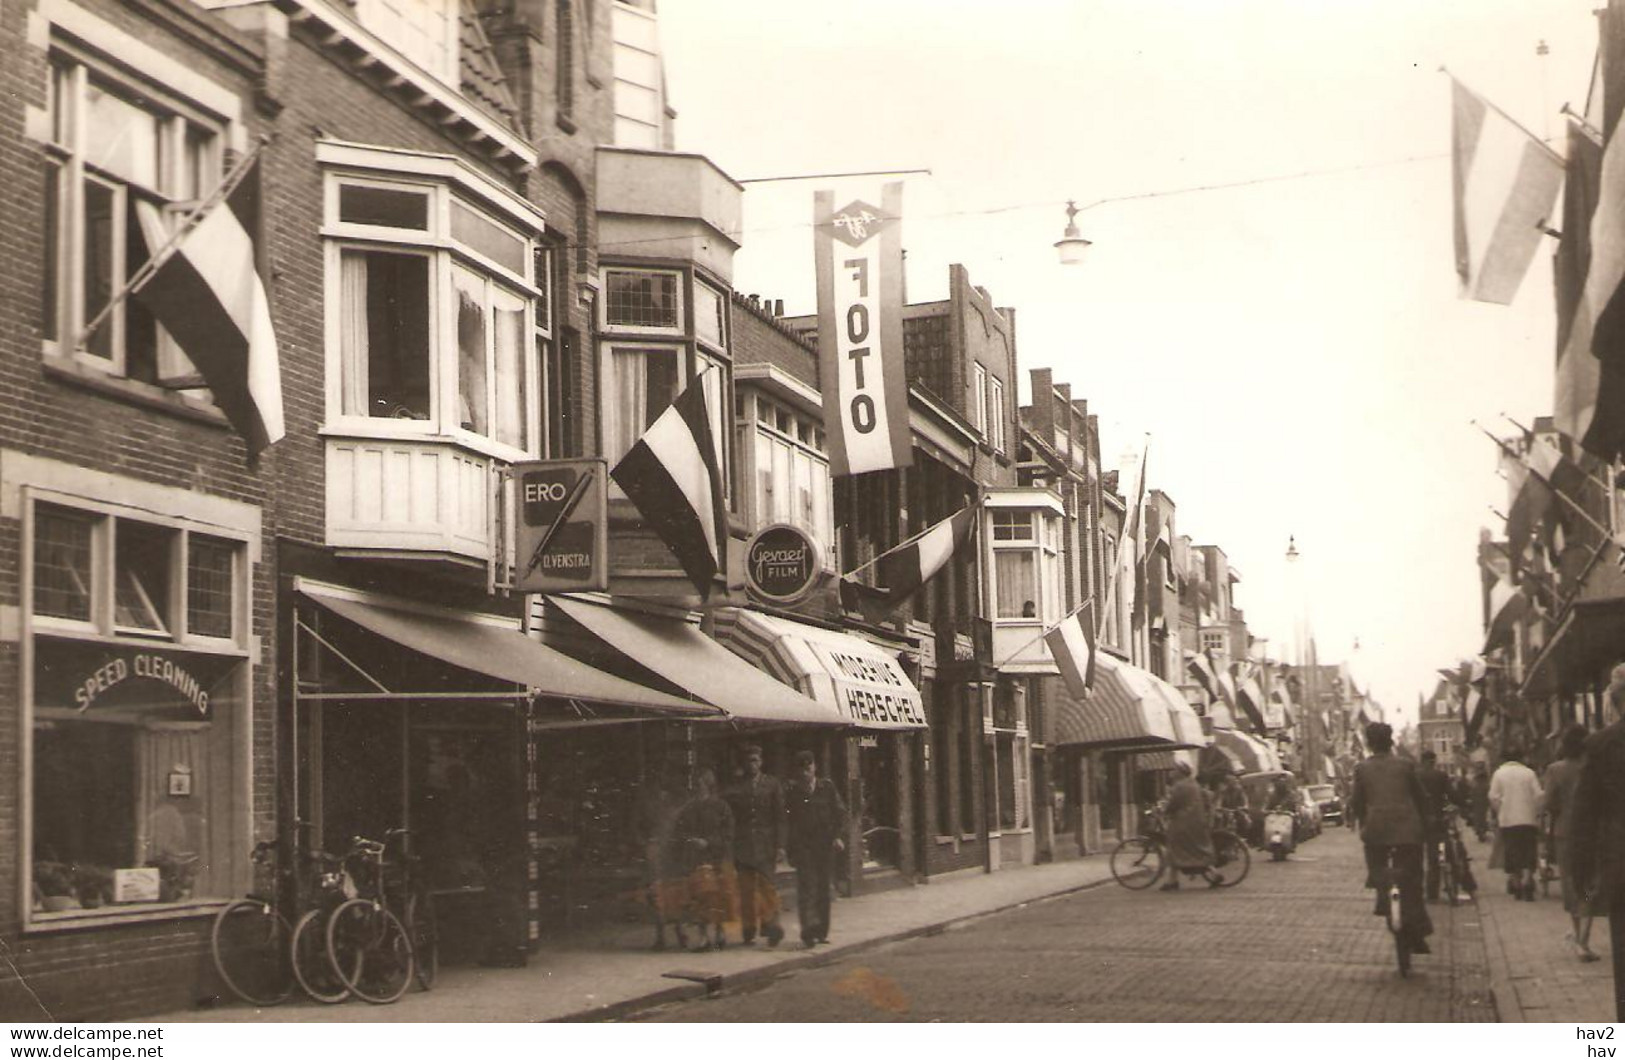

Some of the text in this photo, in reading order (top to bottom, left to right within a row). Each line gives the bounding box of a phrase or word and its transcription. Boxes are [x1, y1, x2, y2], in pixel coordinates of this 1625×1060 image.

[525, 483, 566, 502] ERO
[768, 566, 798, 579] FILM
[75, 654, 208, 715] SPEED CLEANING
[846, 688, 923, 724] HERSCHEL
